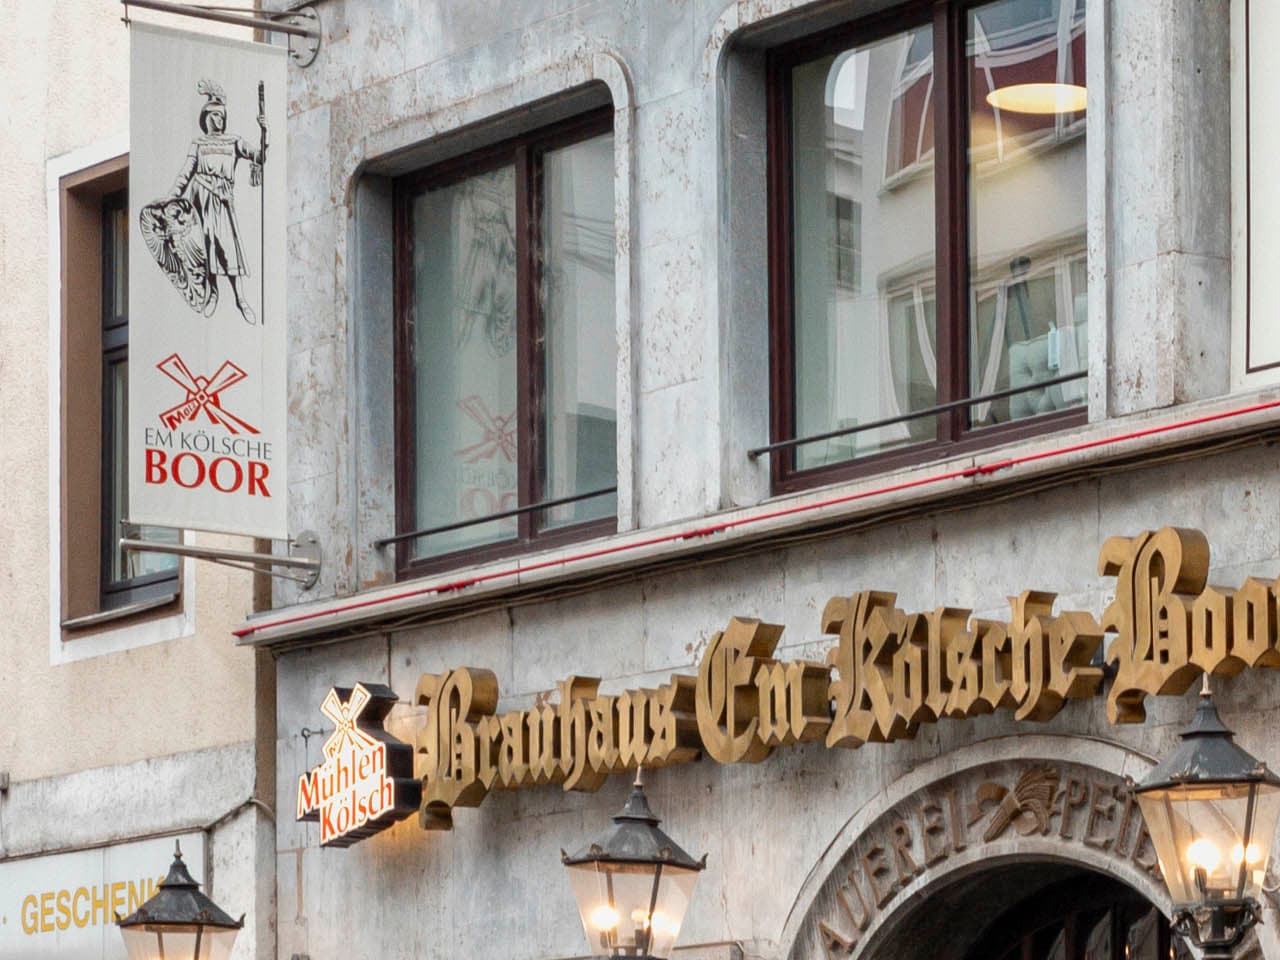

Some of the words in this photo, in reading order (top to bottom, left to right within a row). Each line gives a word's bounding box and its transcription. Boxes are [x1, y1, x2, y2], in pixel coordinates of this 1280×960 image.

[145, 427, 173, 448] EM
[181, 429, 272, 460] KÖLSCHE
[145, 448, 272, 498] BOOR
[416, 667, 698, 829] Brauhaus
[696, 616, 831, 763] Em
[298, 746, 384, 815] Mühlen
[322, 774, 392, 841] Kölsch
